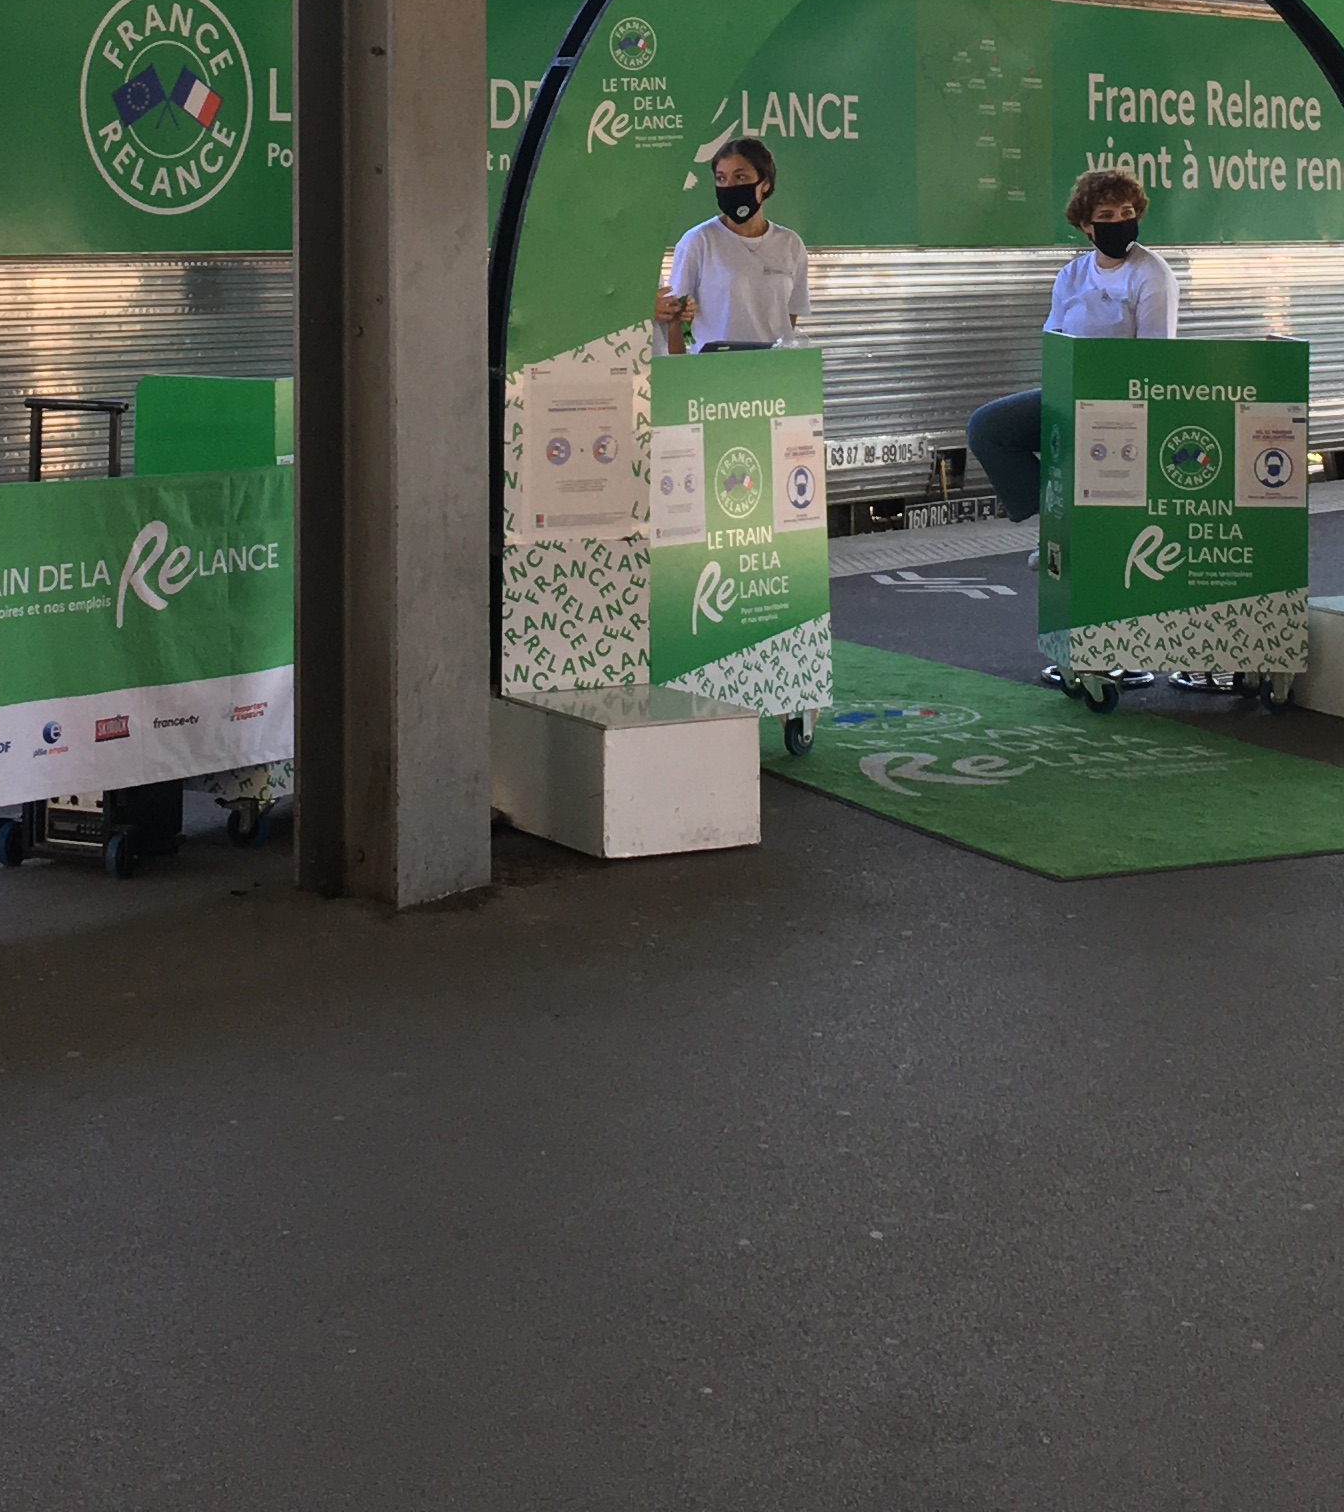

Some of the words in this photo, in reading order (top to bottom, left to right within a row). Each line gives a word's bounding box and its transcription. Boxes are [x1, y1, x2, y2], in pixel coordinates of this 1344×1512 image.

[102, 2, 234, 76] FRANCE
[614, 21, 652, 39] FRANCE
[614, 47, 653, 67] RELANCE
[602, 78, 617, 93] LE
[621, 76, 667, 92] TRAIN
[633, 96, 654, 111] DE
[657, 95, 675, 110] LA
[1087, 72, 1196, 125] France
[1206, 79, 1322, 131] Relance
[98, 119, 237, 198] RELANCE
[1086, 136, 1172, 188] vient
[1182, 139, 1199, 190] à
[1208, 148, 1287, 192] votre
[1128, 378, 1258, 402] Bienvenue
[687, 396, 786, 423] Bienvenue
[1166, 430, 1216, 452] FRANCE
[720, 451, 758, 476] FRANCE
[831, 446, 845, 466] 63
[846, 446, 859, 465] 87
[1166, 463, 1217, 486] RELANCE
[719, 488, 759, 513] RELANCE
[1147, 498, 1168, 516] LE
[1171, 499, 1233, 516] TRAIN
[907, 508, 927, 530] 160
[929, 504, 948, 526] RIC
[707, 530, 724, 550] LE
[726, 525, 773, 548] TRAIN
[1188, 522, 1214, 540] DE
[1219, 523, 1244, 540] LA
[739, 553, 759, 573] DE
[762, 550, 782, 570] LA
[38, 564, 73, 593] DE
[80, 559, 112, 587] LA
[27, 603, 41, 616] et
[43, 602, 65, 614] nos
[68, 595, 112, 614] emplois
